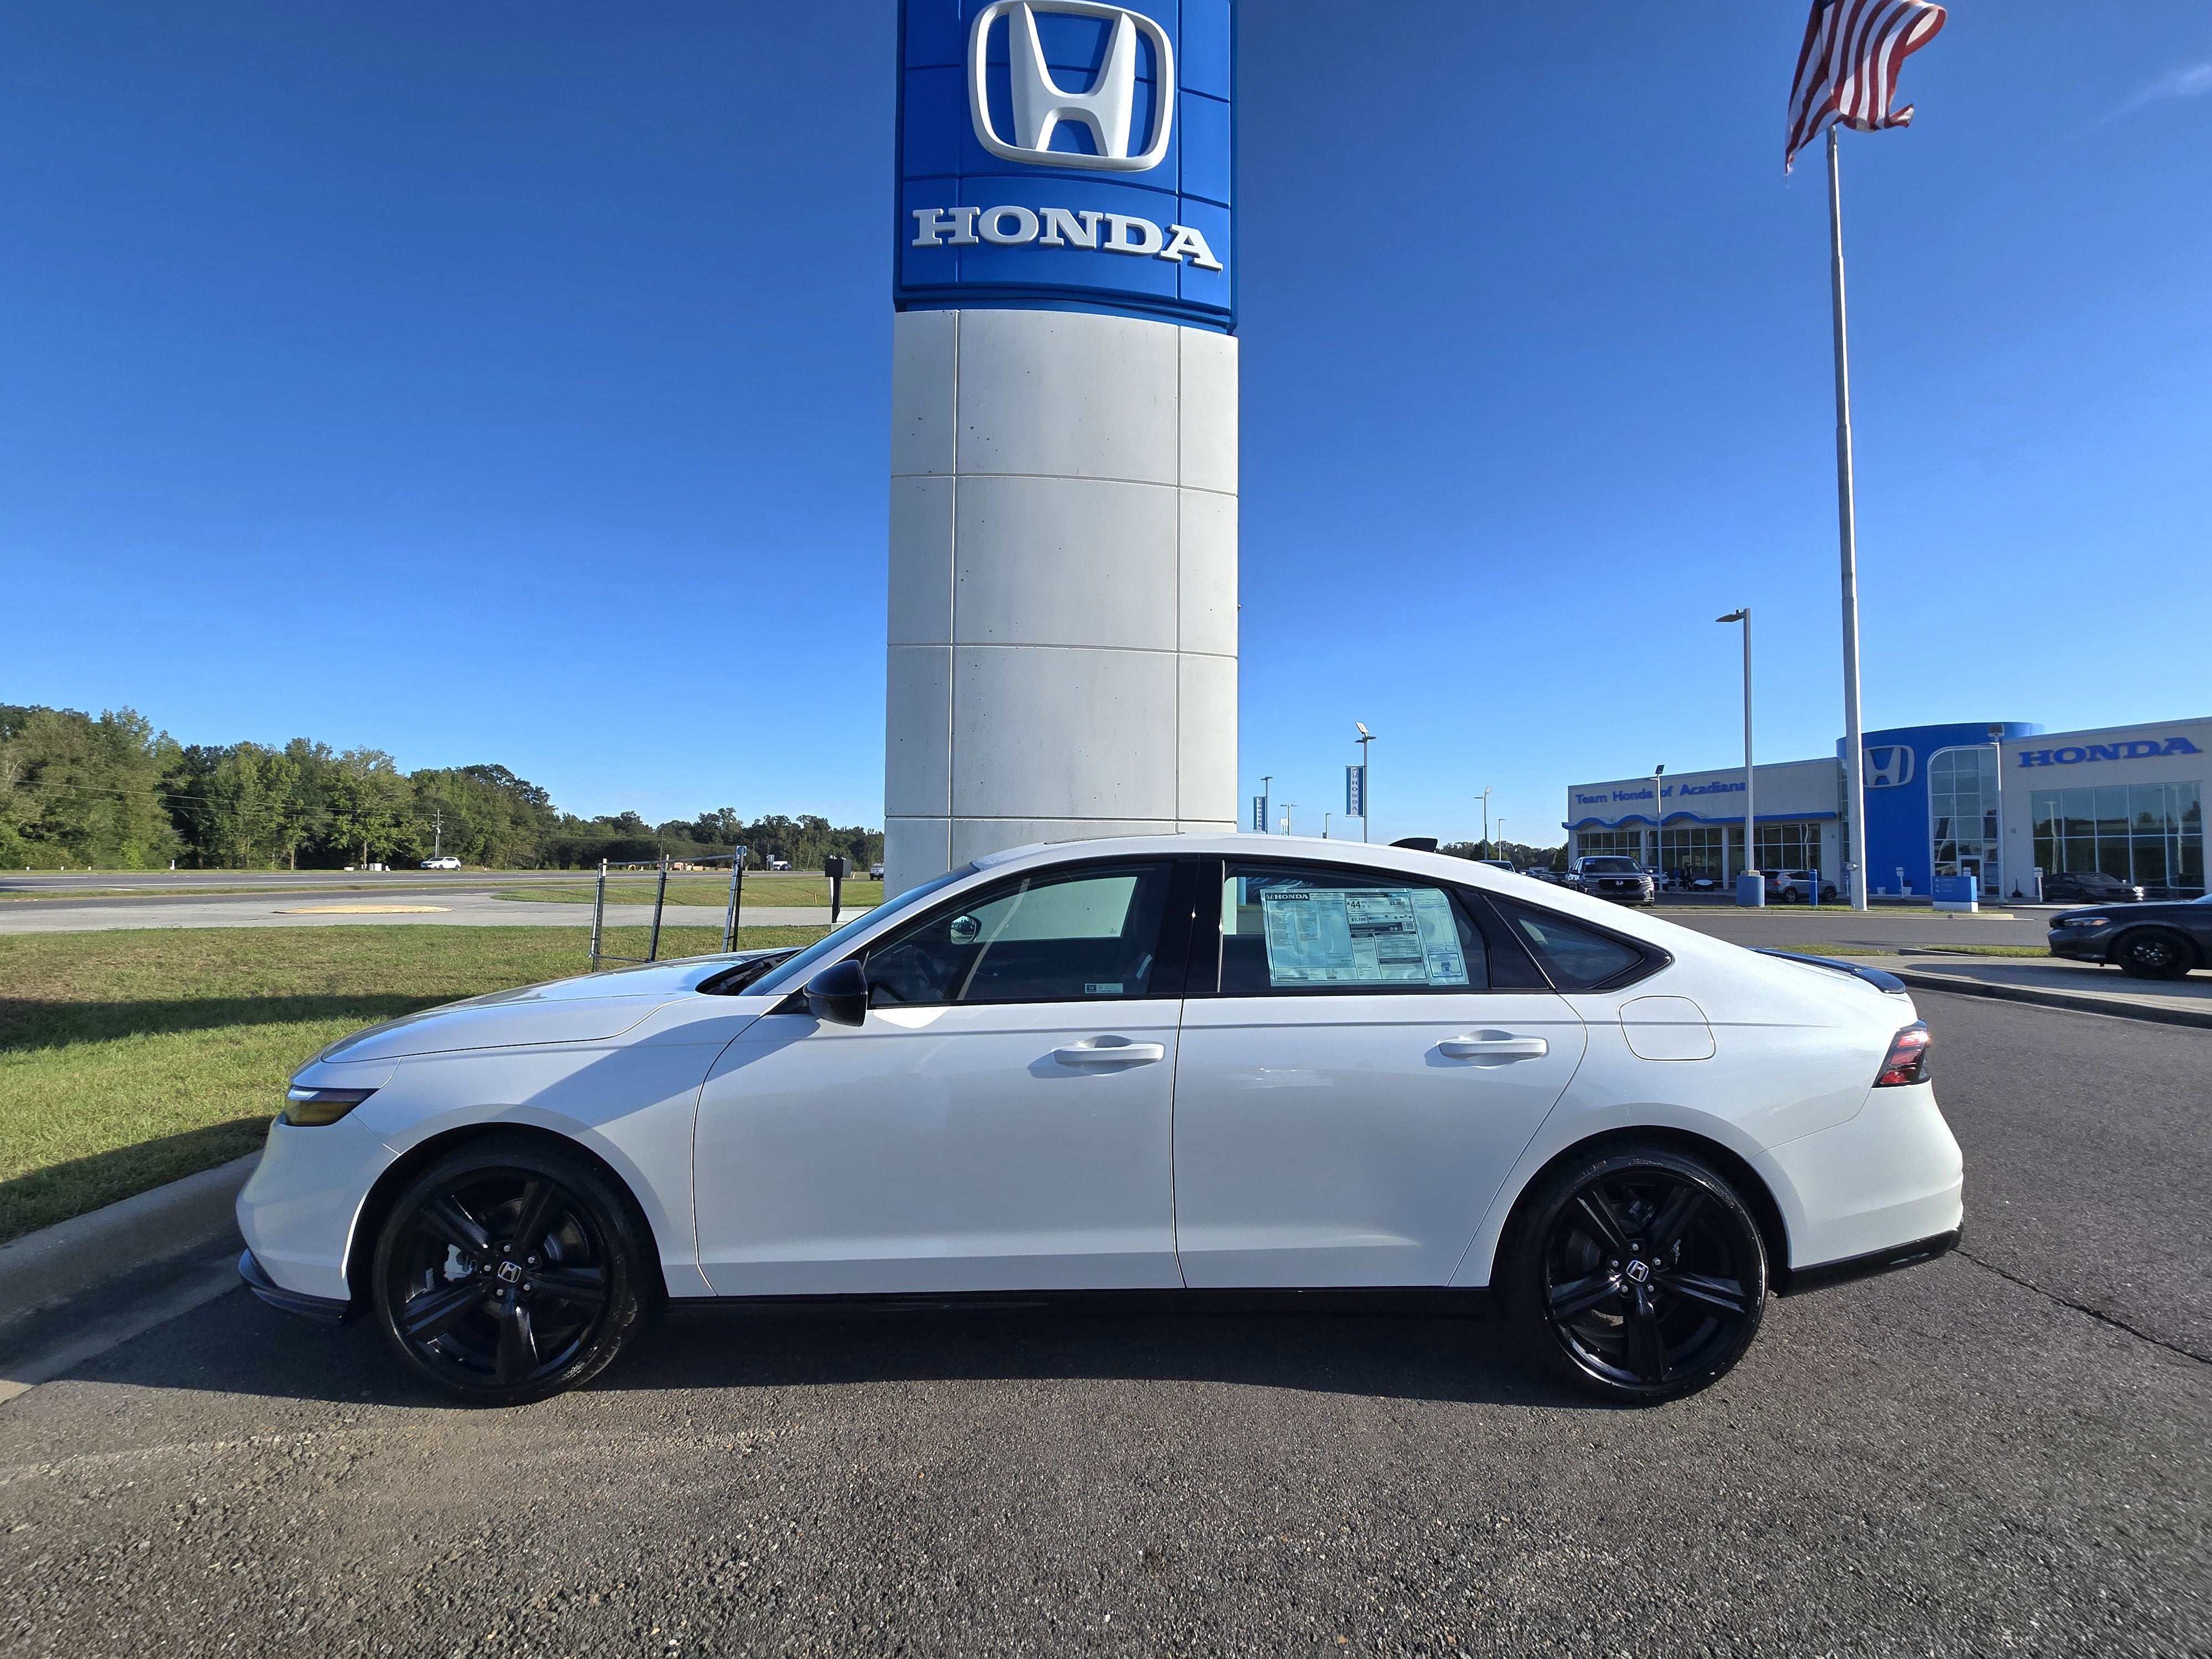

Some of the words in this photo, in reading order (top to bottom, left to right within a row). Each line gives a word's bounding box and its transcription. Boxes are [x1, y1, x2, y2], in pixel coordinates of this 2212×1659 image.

[912, 205, 1223, 272] HONDA
[2018, 737, 2203, 768] HONDA
[1575, 794, 1608, 805] Team
[1612, 788, 1653, 802] Honda
[1660, 785, 1673, 797] of
[1679, 781, 1746, 796] Acadiana
